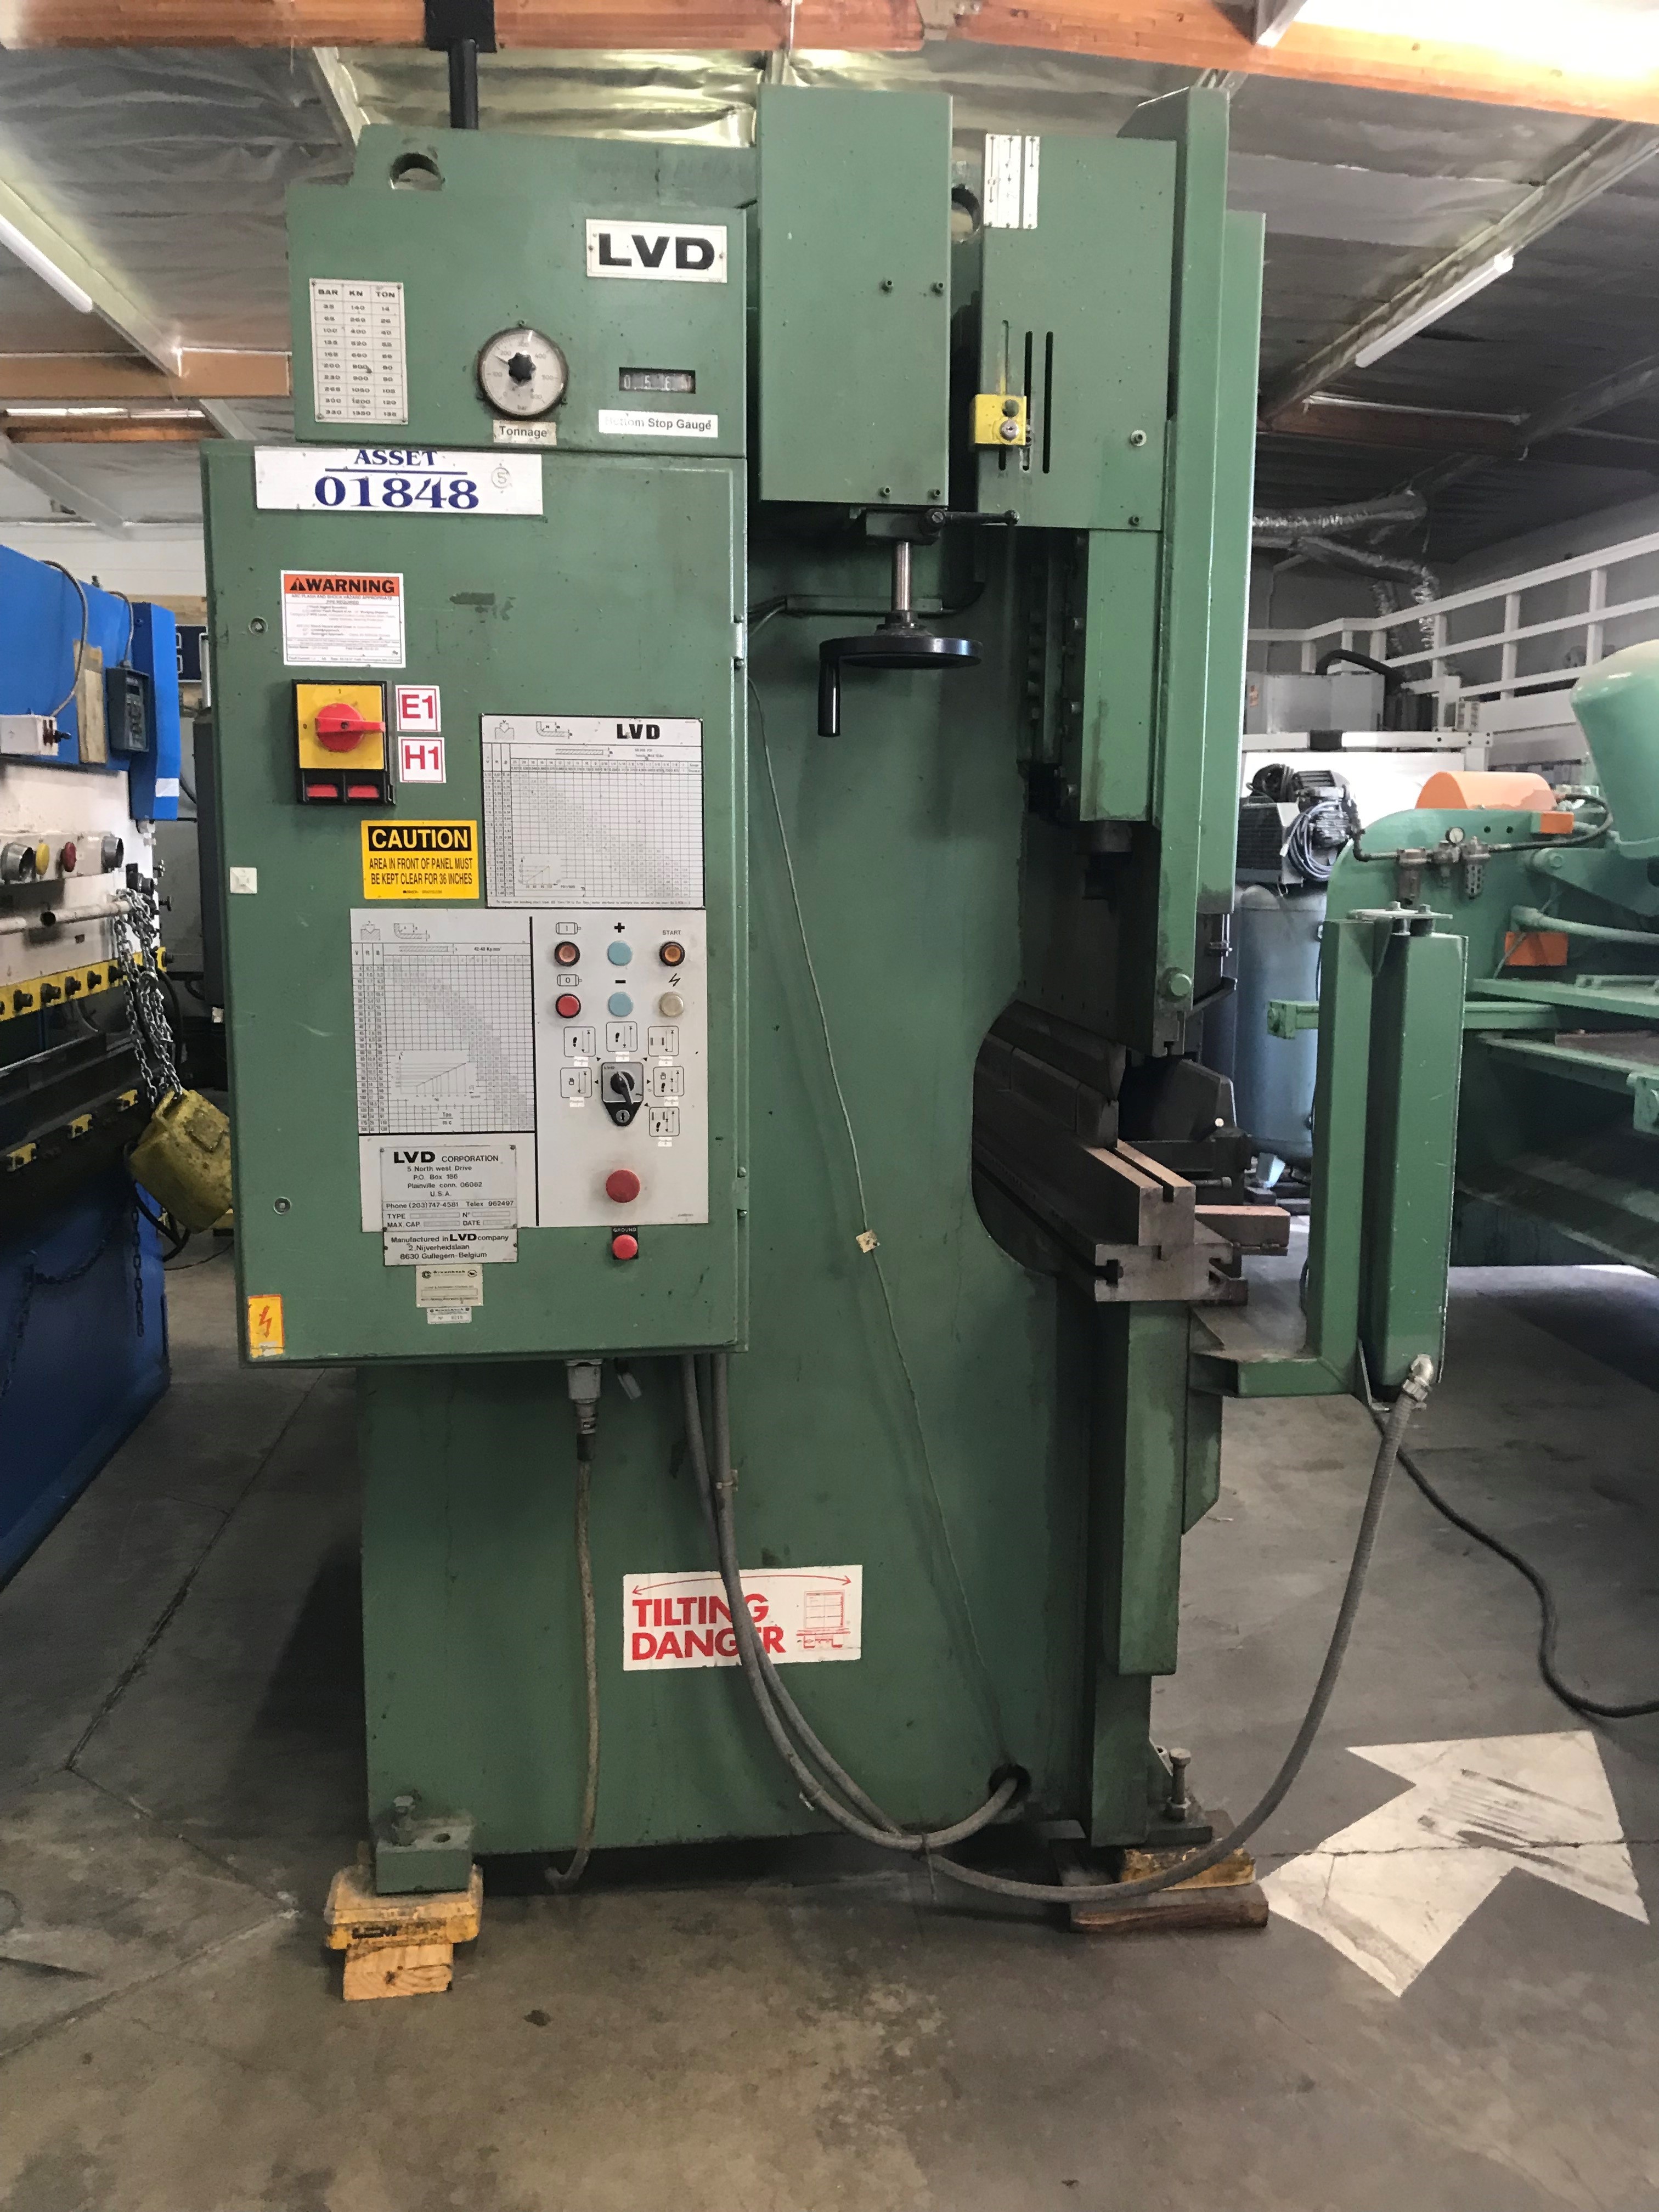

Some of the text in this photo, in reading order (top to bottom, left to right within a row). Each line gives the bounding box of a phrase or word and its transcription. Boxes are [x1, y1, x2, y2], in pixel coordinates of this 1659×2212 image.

[599, 233, 715, 270] LVD
[499, 425, 548, 439] Tonnage
[648, 417, 673, 430] Stop
[676, 419, 712, 432] Gauge
[354, 449, 438, 466] ASSET
[315, 476, 479, 510] 01848
[306, 578, 394, 594] WARNING
[402, 695, 433, 719] E1
[617, 724, 660, 740] LVD
[405, 745, 438, 770] H1
[371, 829, 468, 848] CAUTION
[370, 857, 472, 870] AREA IN FRONT OF PANEL MUST
[371, 873, 472, 884] BE KEPT CLEAR FOR 36 INCHES
[394, 1152, 436, 1164] LVD
[449, 1233, 477, 1242] LVD
[633, 1593, 769, 1627] TILTING
[633, 1625, 786, 1661] DANGR
